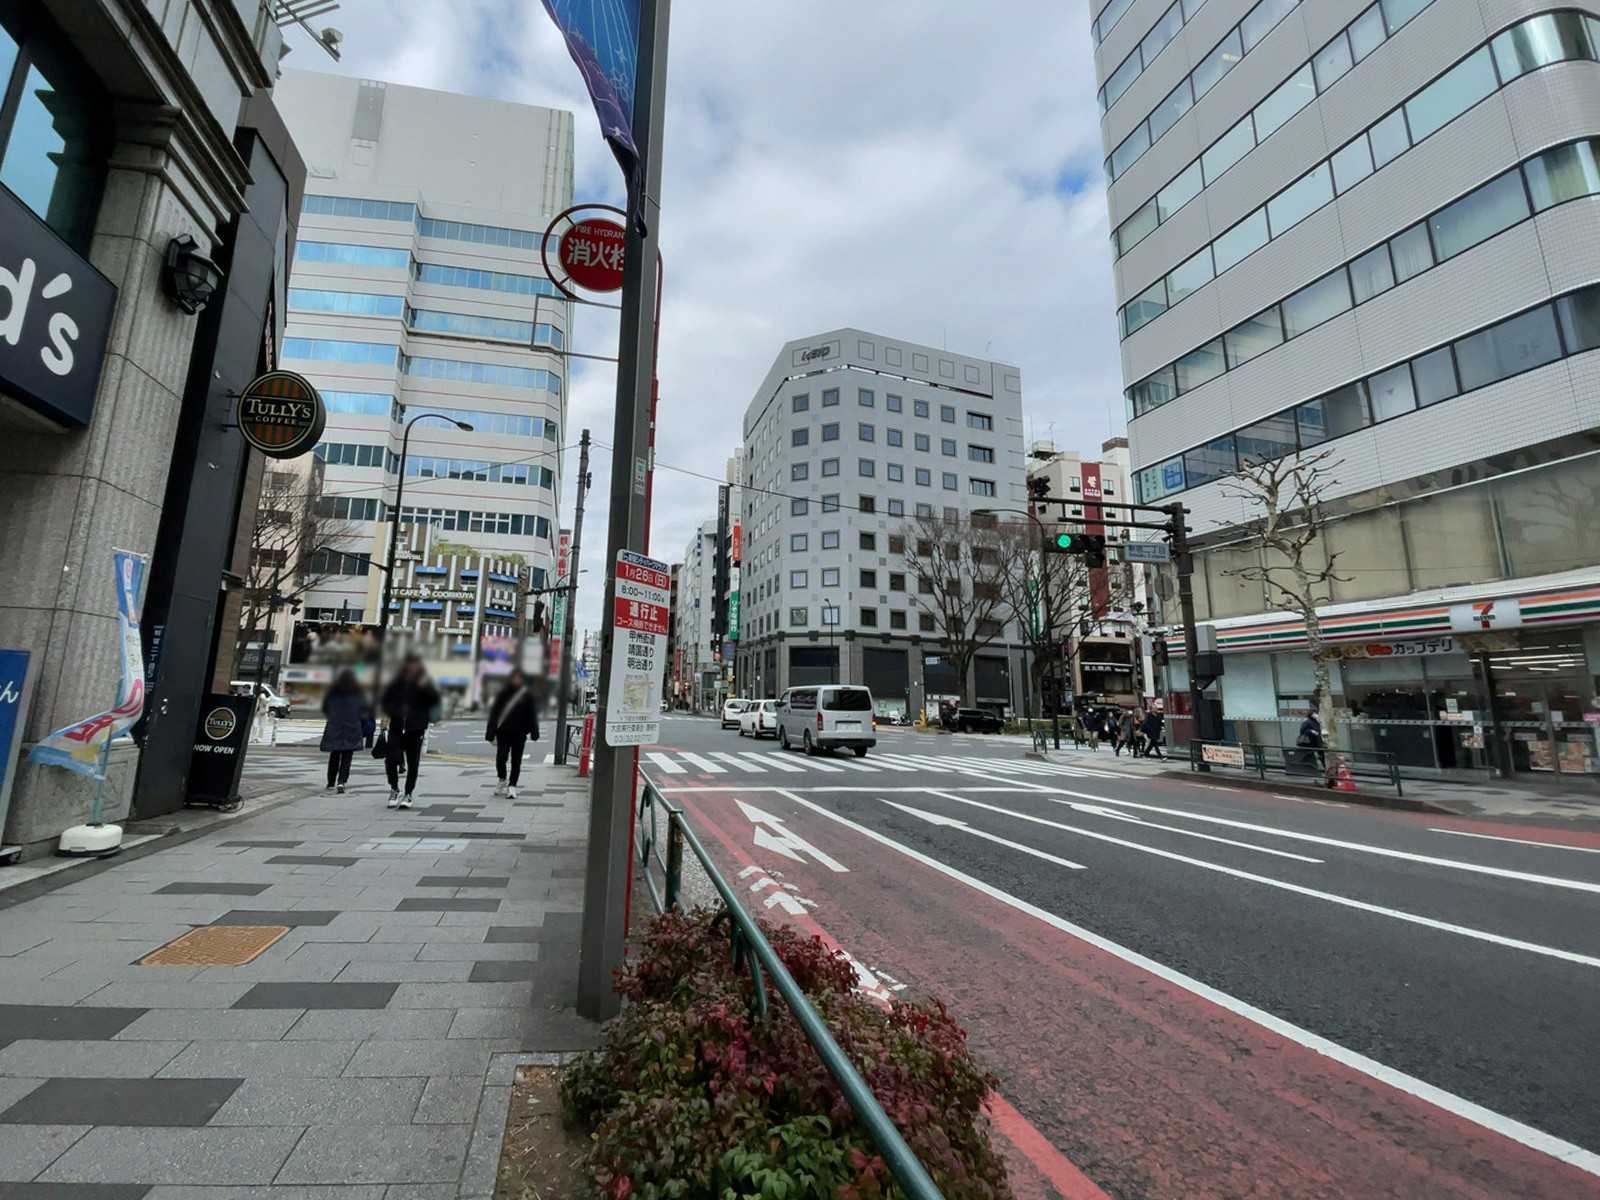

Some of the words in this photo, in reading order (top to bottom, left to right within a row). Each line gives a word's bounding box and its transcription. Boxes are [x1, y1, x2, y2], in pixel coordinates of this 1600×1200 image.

[575, 225, 592, 235] FIRE
[255, 416, 297, 425] COFFEE
[629, 601, 658, 621] 通行止
[629, 630, 656, 645] 甲州街道
[628, 644, 655, 657] 靖国通り
[1394, 639, 1453, 654] カップデリ
[627, 657, 654, 670] 明治通り
[0, 680, 19, 704] ん
[193, 744, 212, 752] NOW
[214, 745, 235, 754] OPEN
